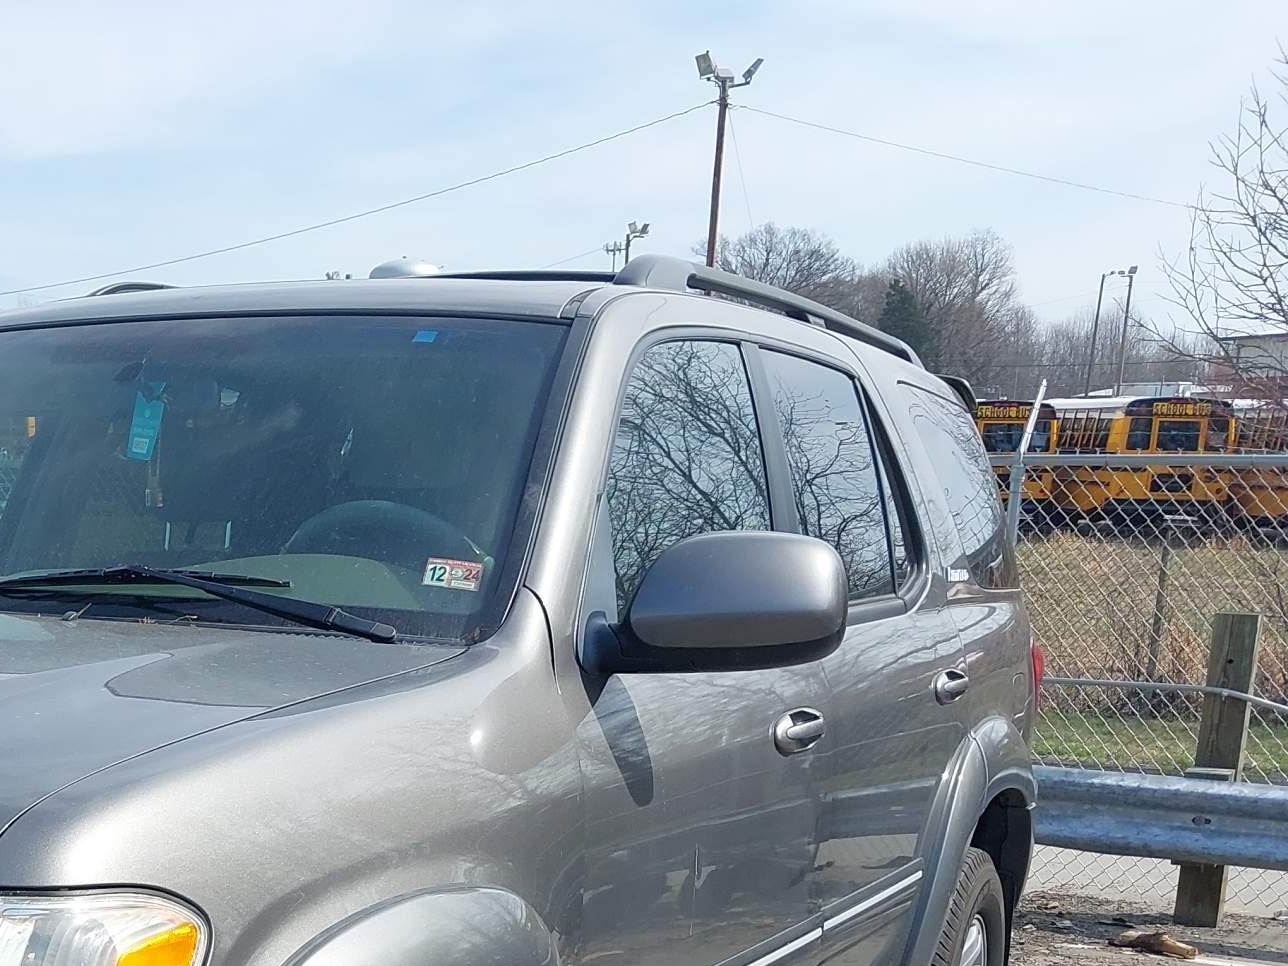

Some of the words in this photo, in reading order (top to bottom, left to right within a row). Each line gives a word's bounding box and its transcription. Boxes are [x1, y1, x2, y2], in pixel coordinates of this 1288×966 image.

[977, 405, 1015, 418] SCHOOL
[1154, 403, 1191, 416] SCHOOL
[430, 565, 447, 582] 12
[464, 568, 480, 581] 24
